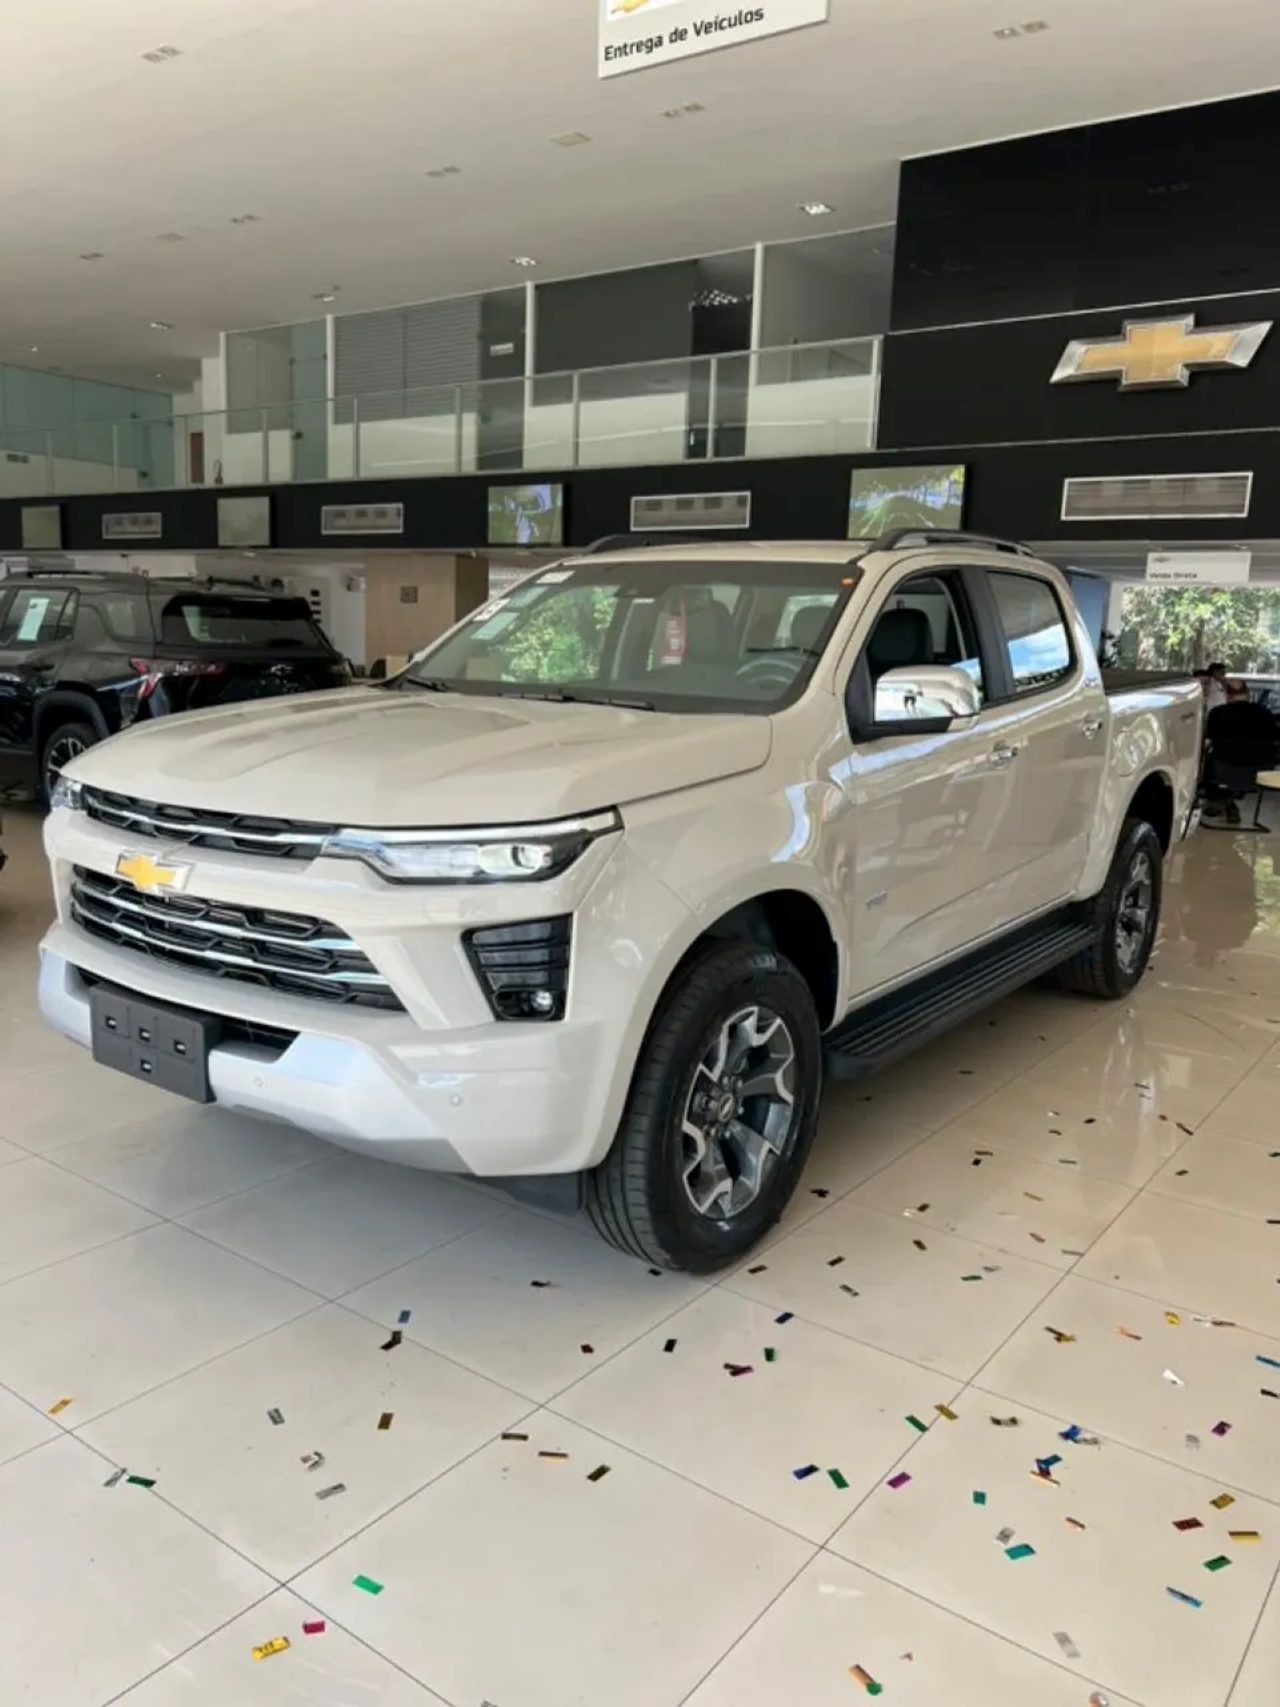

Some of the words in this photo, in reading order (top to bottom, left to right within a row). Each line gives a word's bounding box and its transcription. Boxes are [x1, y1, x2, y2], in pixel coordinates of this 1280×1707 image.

[604, 34, 663, 61] Entrega
[668, 26, 688, 43] de
[693, 8, 764, 37] Veículos
